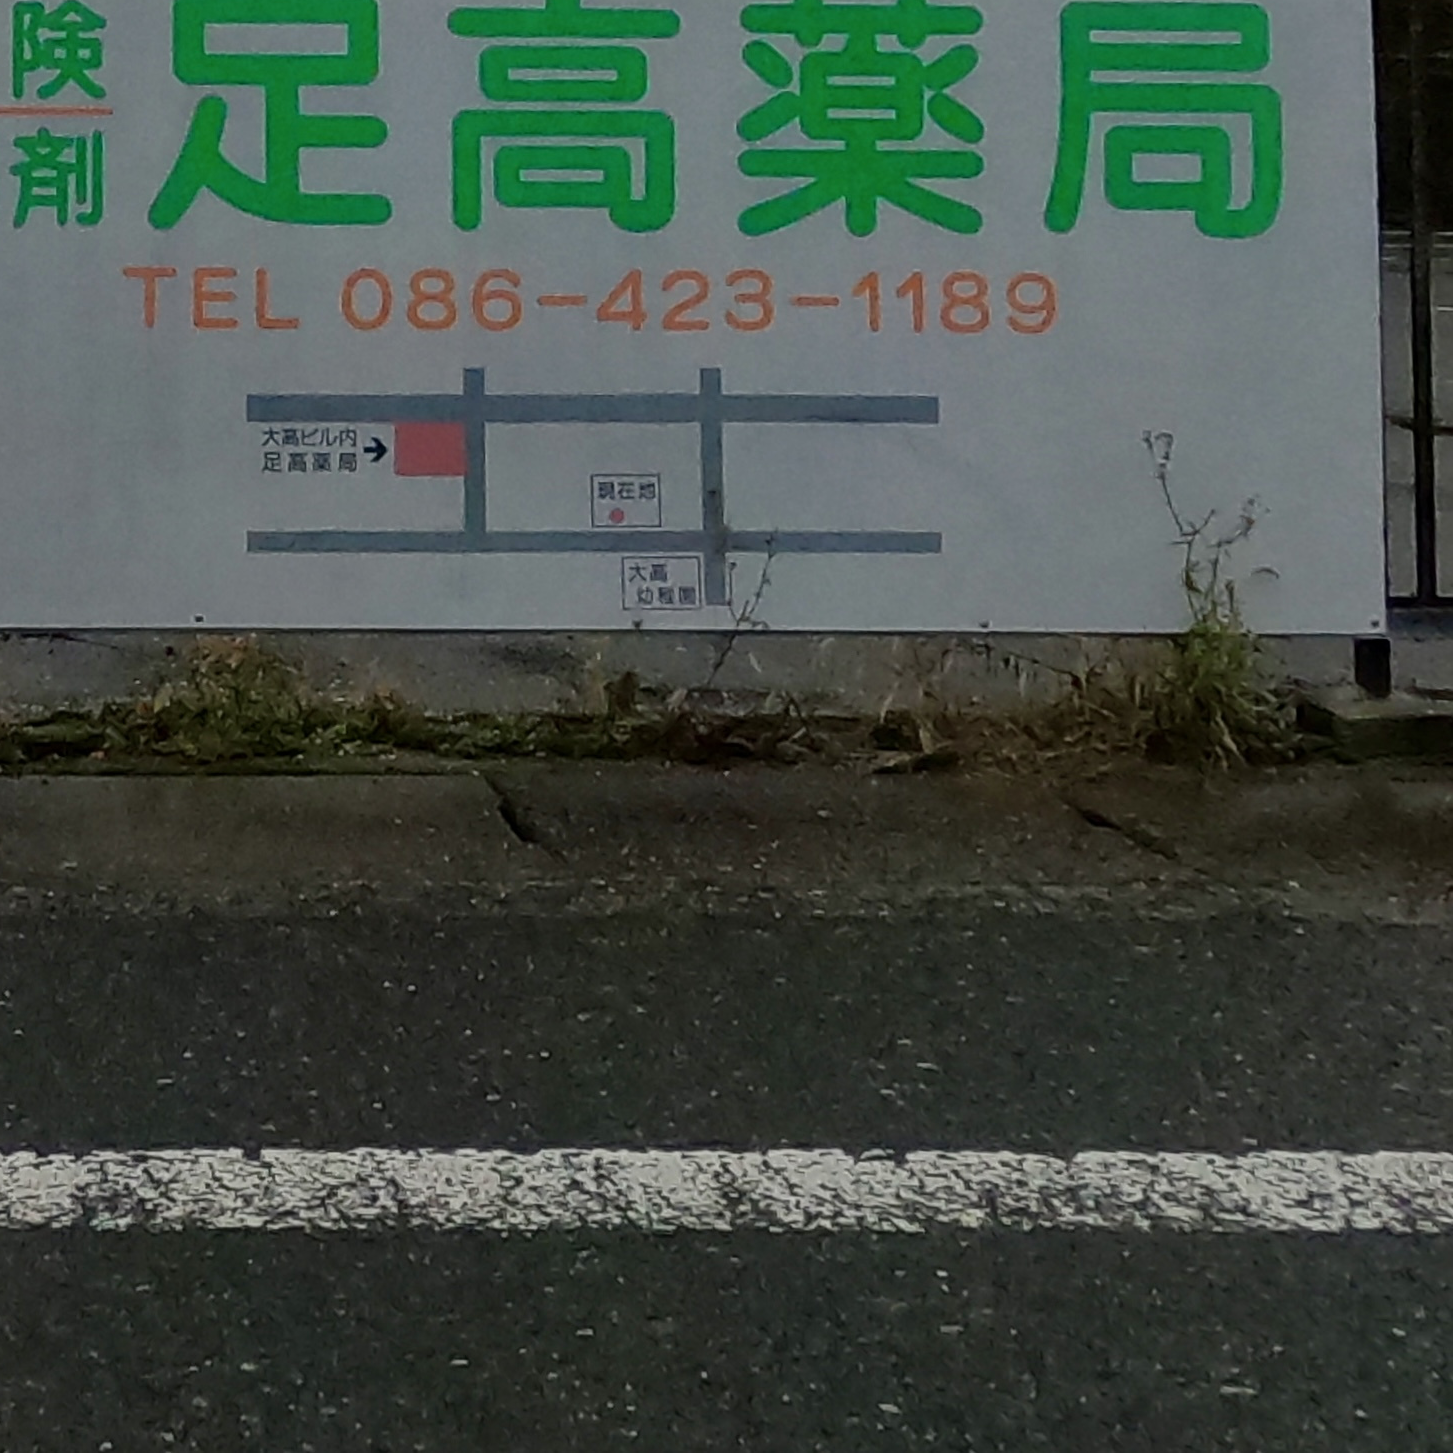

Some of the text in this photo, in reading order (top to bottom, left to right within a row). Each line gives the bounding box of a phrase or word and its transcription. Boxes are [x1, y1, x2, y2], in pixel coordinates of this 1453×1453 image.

[124, 267, 1057, 334] TEL 086-423-1189
[261, 427, 358, 448] 大高ビル内
